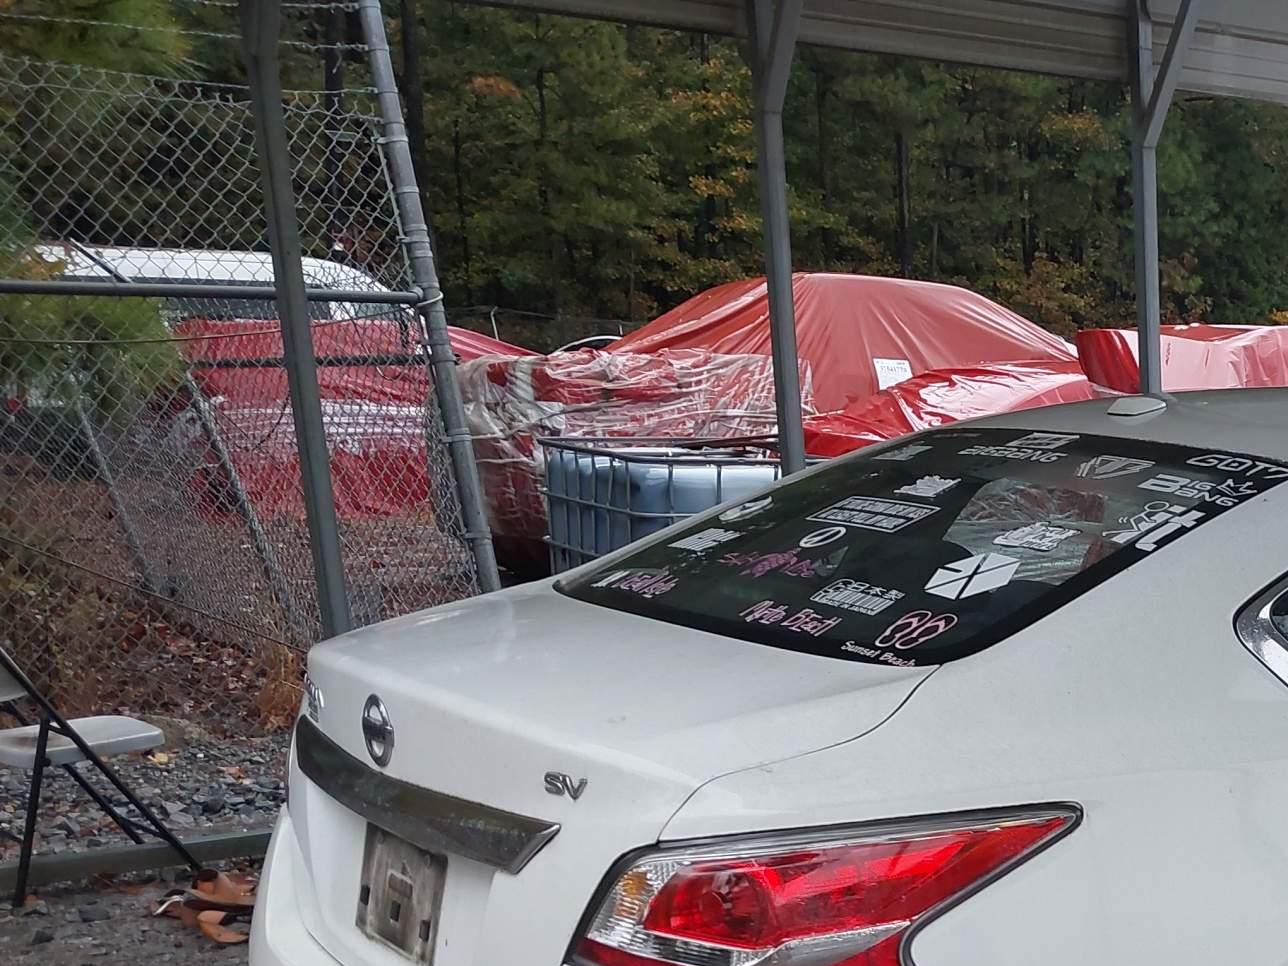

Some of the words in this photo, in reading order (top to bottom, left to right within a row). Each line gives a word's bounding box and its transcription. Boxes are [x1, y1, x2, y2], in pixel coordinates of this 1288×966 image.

[841, 641, 881, 658] Sunset
[879, 652, 916, 667] Beach
[544, 771, 588, 801] SV
